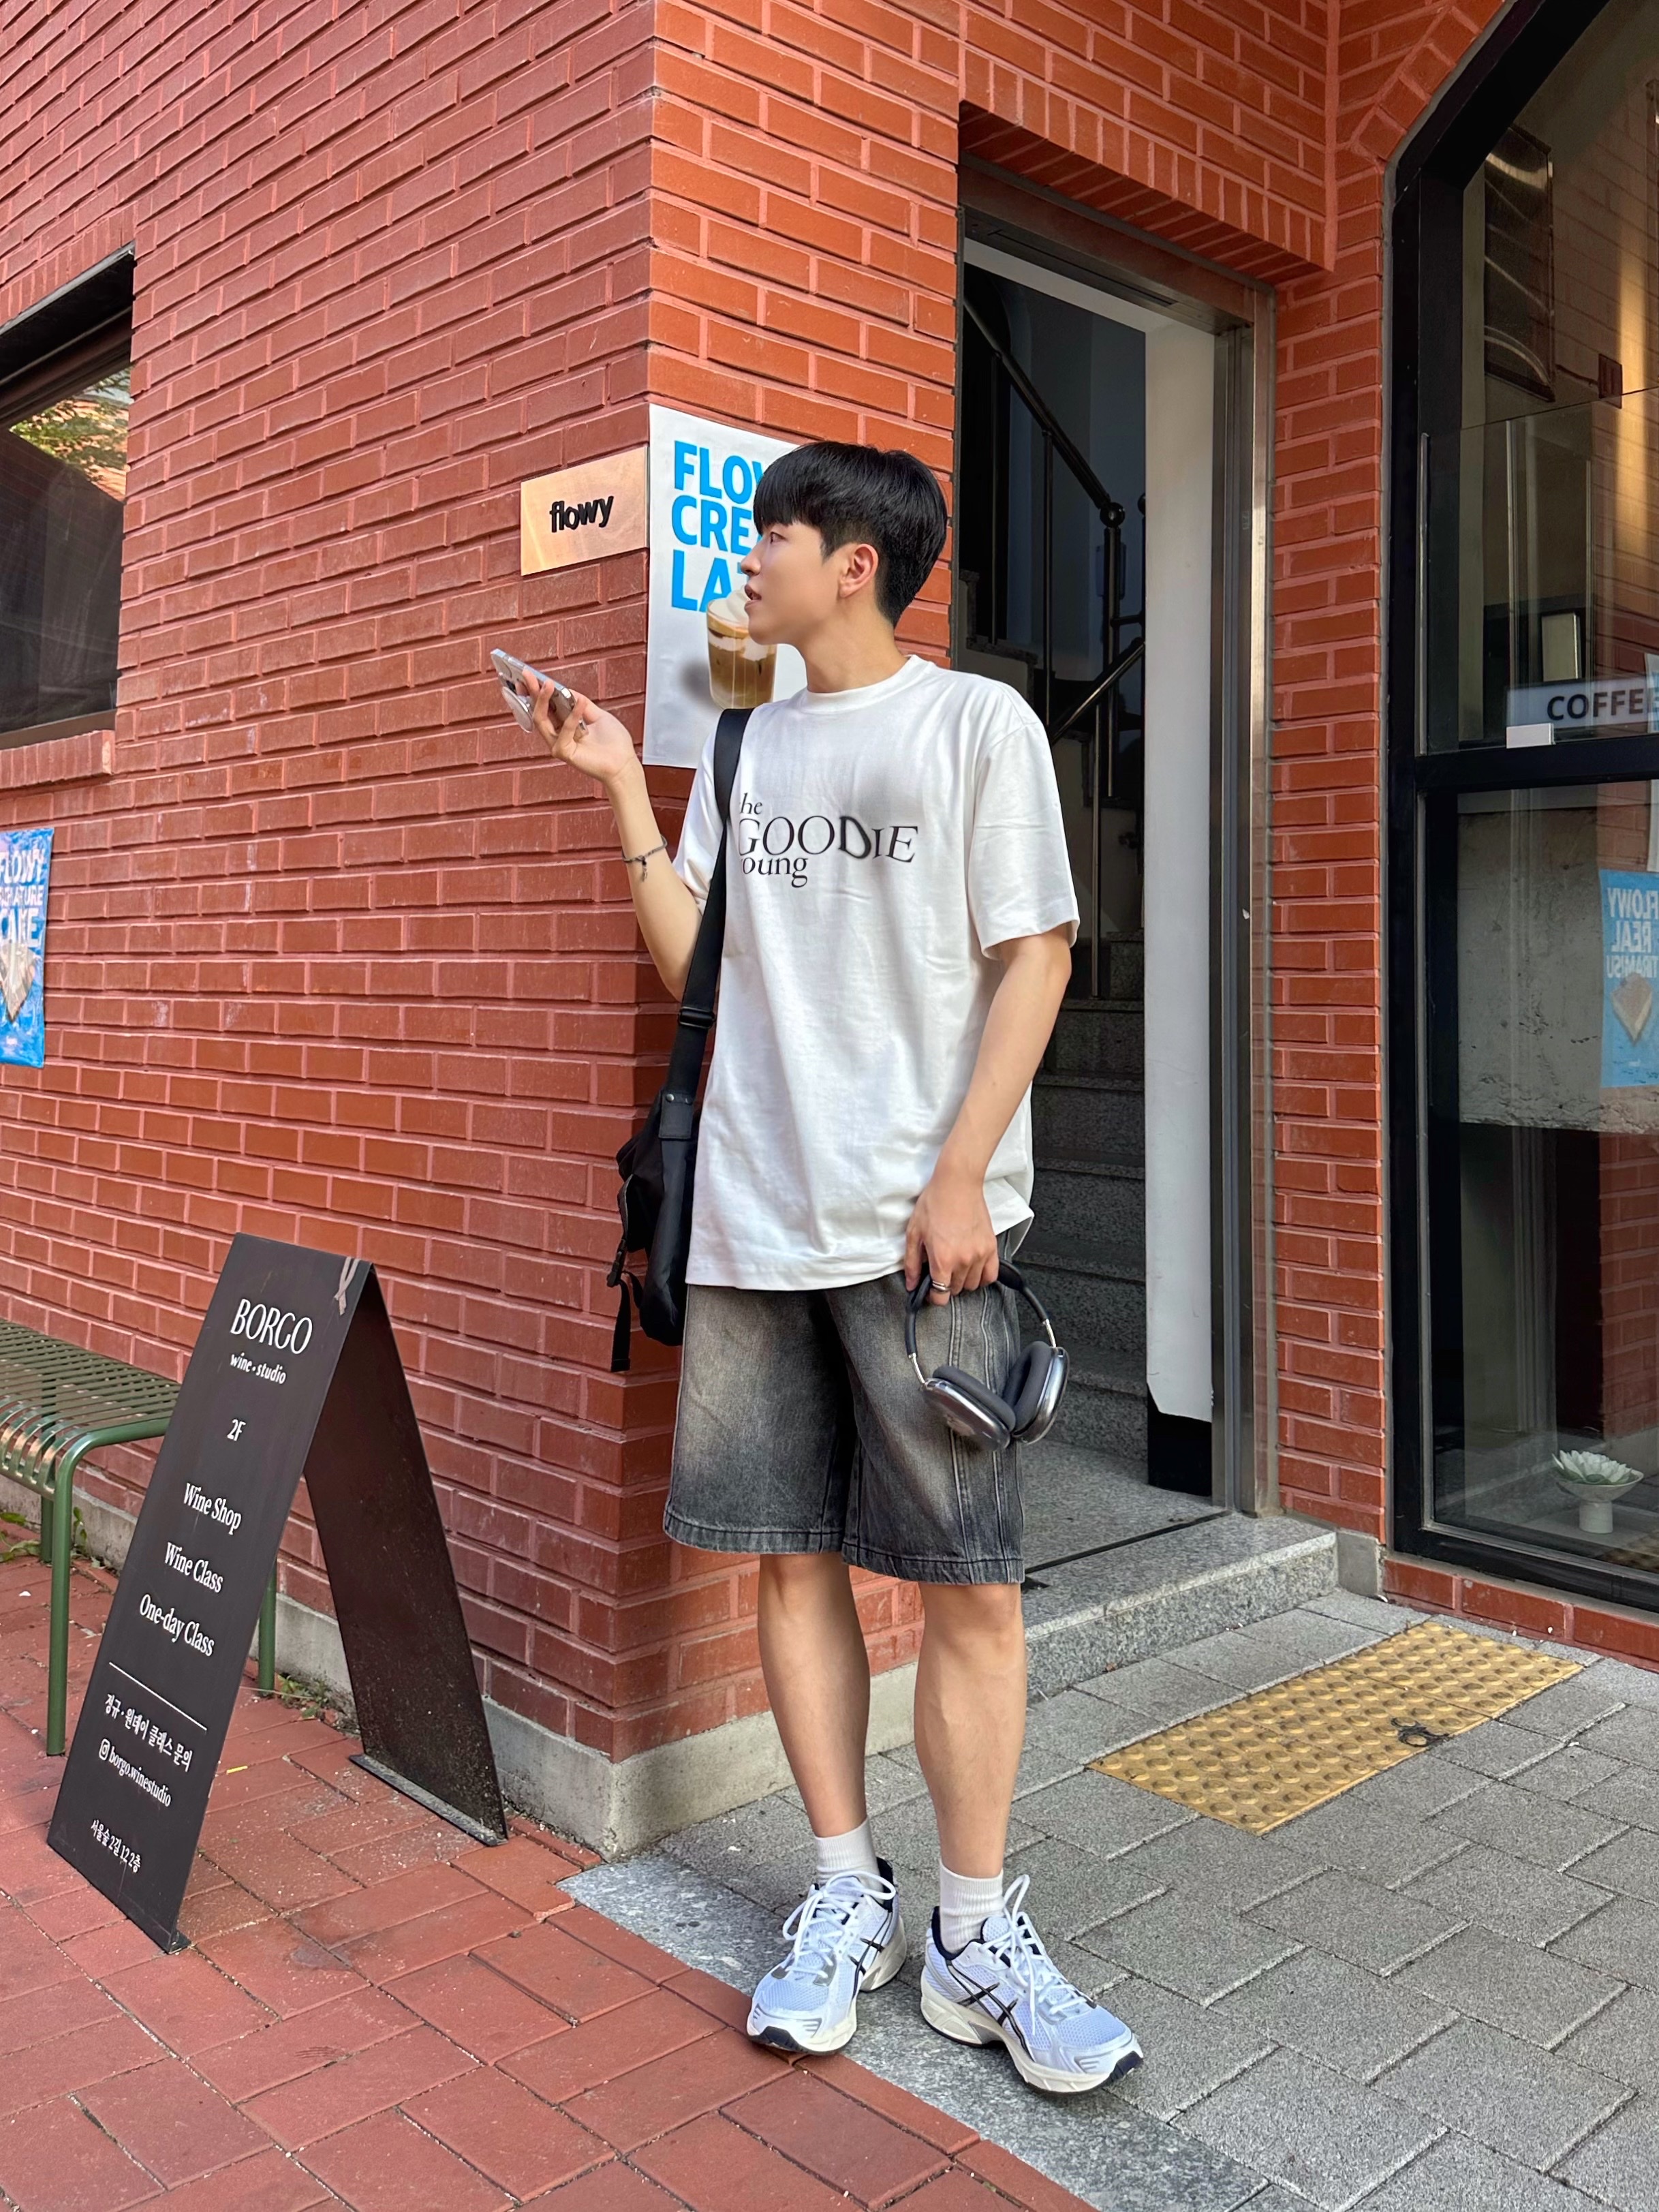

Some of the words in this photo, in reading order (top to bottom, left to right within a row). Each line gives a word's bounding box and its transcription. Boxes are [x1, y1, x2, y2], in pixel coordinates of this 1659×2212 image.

[549, 495, 614, 533] flowy
[672, 495, 760, 555] CRE
[671, 549, 749, 613] LA
[739, 793, 762, 814] he
[739, 816, 918, 863] GOODIE
[741, 857, 809, 888] oung
[230, 1299, 313, 1354] BORGO
[227, 1419, 246, 1441] 2F
[183, 1483, 212, 1515] Wine
[211, 1498, 242, 1535] Shop
[164, 1542, 193, 1576] Wine
[193, 1559, 223, 1593] Class
[140, 1594, 185, 1643] One-day
[184, 1621, 215, 1657] Class
[149, 1725, 172, 1755] 클래스
[174, 1743, 192, 1772] 문의
[109, 1746, 171, 1807] borgo.winestudio
